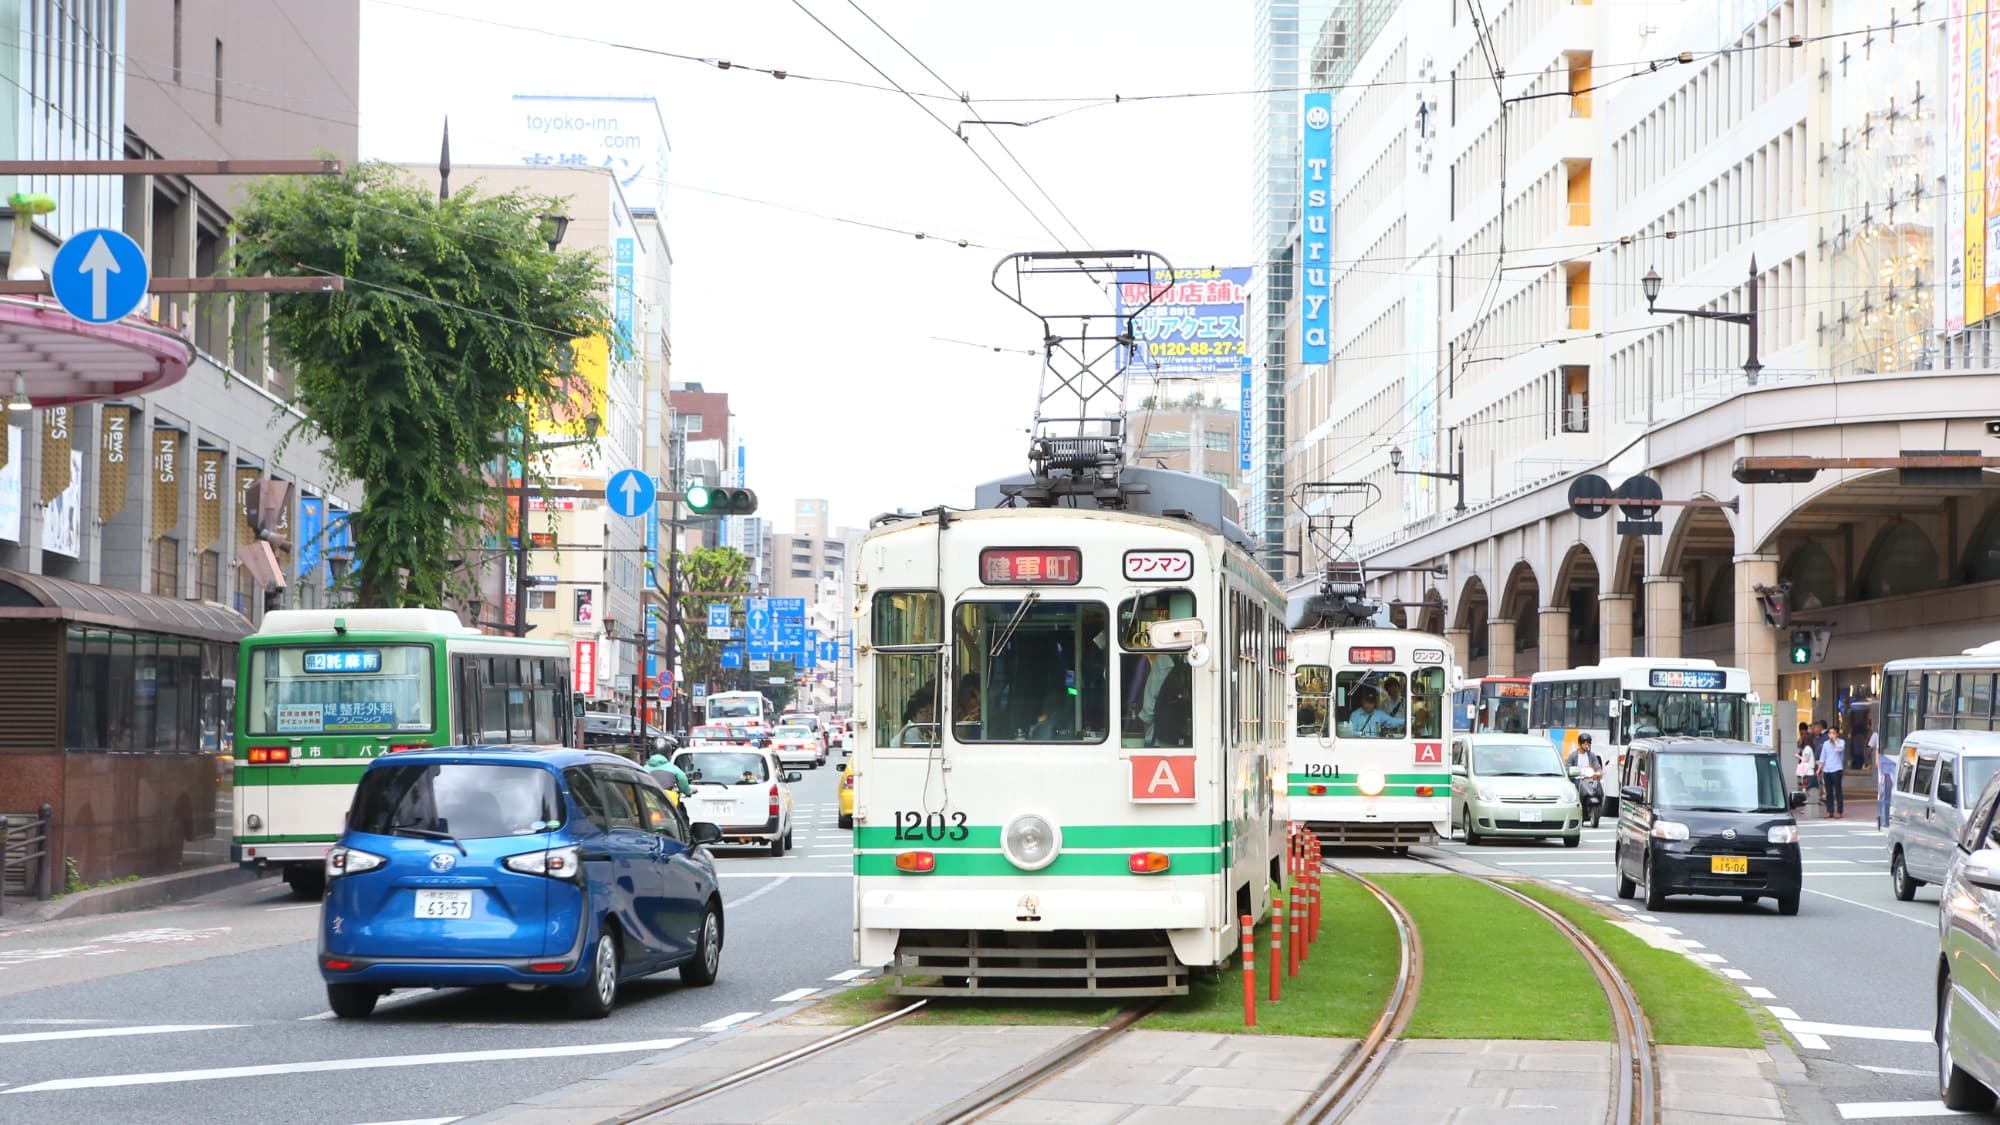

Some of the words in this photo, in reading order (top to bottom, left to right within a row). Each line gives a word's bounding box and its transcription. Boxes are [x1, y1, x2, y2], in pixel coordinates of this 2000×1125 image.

[527, 114, 618, 133] toyoko-inn
[600, 135, 641, 148] .com
[1306, 158, 1328, 346] Tsuruya
[51, 407, 67, 439] ewS
[985, 555, 1072, 582] 健軍町
[1128, 557, 1188, 572] ワンマン
[1415, 652, 1442, 661] ワンマン
[1421, 747, 1436, 761] A
[1148, 760, 1180, 793] A
[1304, 764, 1340, 779] 1201
[894, 811, 969, 841] 1203
[427, 902, 468, 916] 63-57
